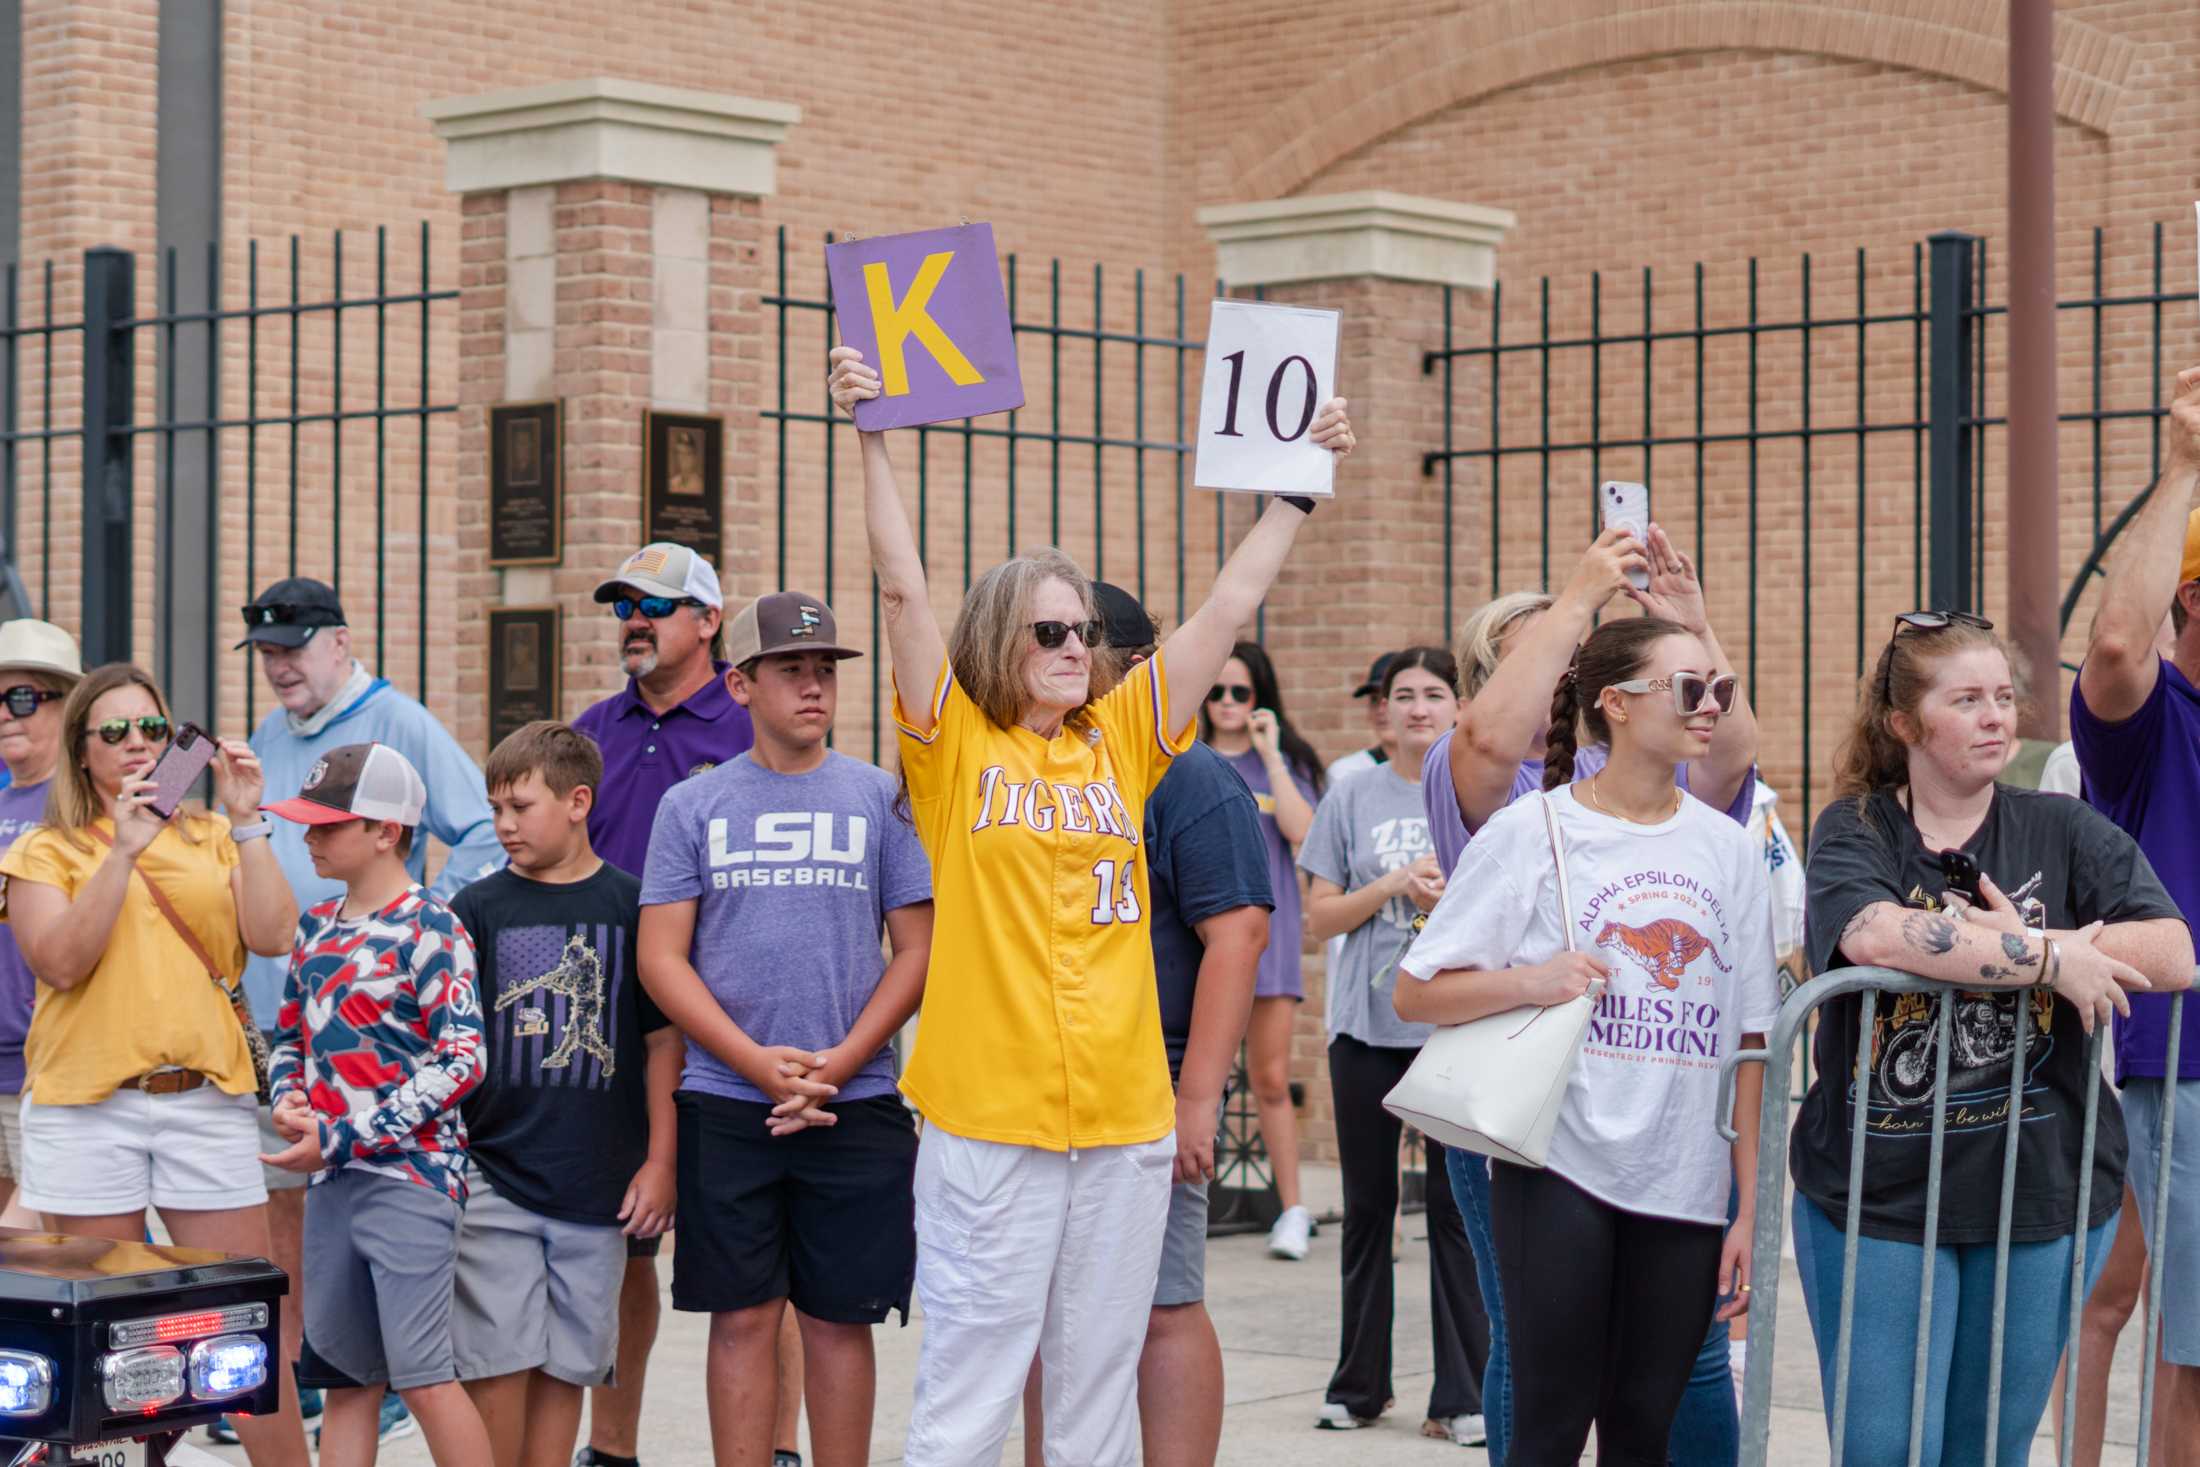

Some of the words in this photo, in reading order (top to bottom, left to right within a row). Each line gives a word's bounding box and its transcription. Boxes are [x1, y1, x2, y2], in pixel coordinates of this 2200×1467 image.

[863, 251, 986, 397] K
[1214, 350, 1318, 442] 10
[972, 765, 1139, 846] TIGERS
[708, 811, 868, 867] LSU
[711, 867, 869, 890] BASEBALL
[1627, 890, 1669, 905] SPRING
[1579, 881, 1625, 933] ALPHA
[1623, 870, 1699, 893] EPSILON
[1607, 967, 1622, 977] ST
[1681, 1001, 1720, 1029] FO
[1870, 1112, 1924, 1130] born
[1956, 1106, 1979, 1125] be
[1981, 1098, 2020, 1121] wil
